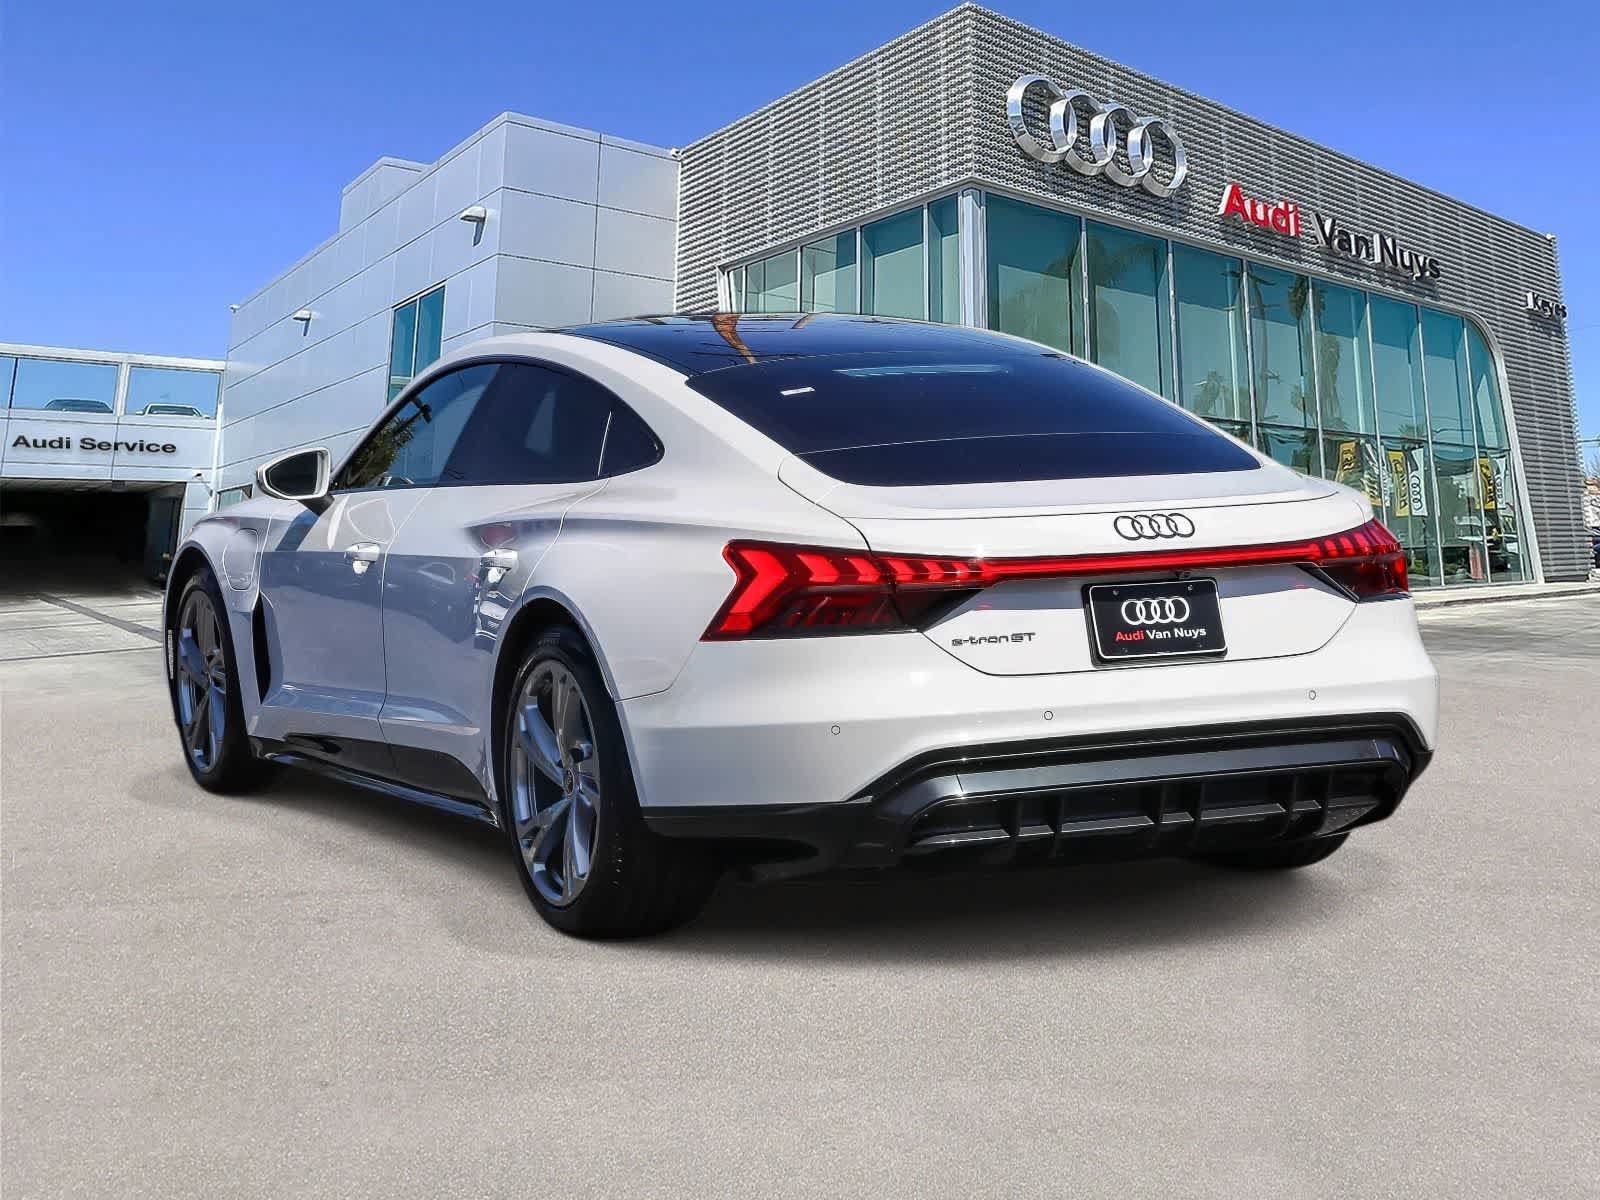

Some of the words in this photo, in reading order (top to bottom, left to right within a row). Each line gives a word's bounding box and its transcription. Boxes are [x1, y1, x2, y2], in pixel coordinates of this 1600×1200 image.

[1217, 182, 1301, 237] Audi
[1312, 211, 1370, 259] Van
[1373, 232, 1441, 280] Nuys
[12, 434, 71, 449] Audi
[79, 437, 177, 454] Service
[1115, 630, 1144, 642] Audi
[1146, 628, 1171, 640] Van
[1174, 627, 1207, 639] Nuys
